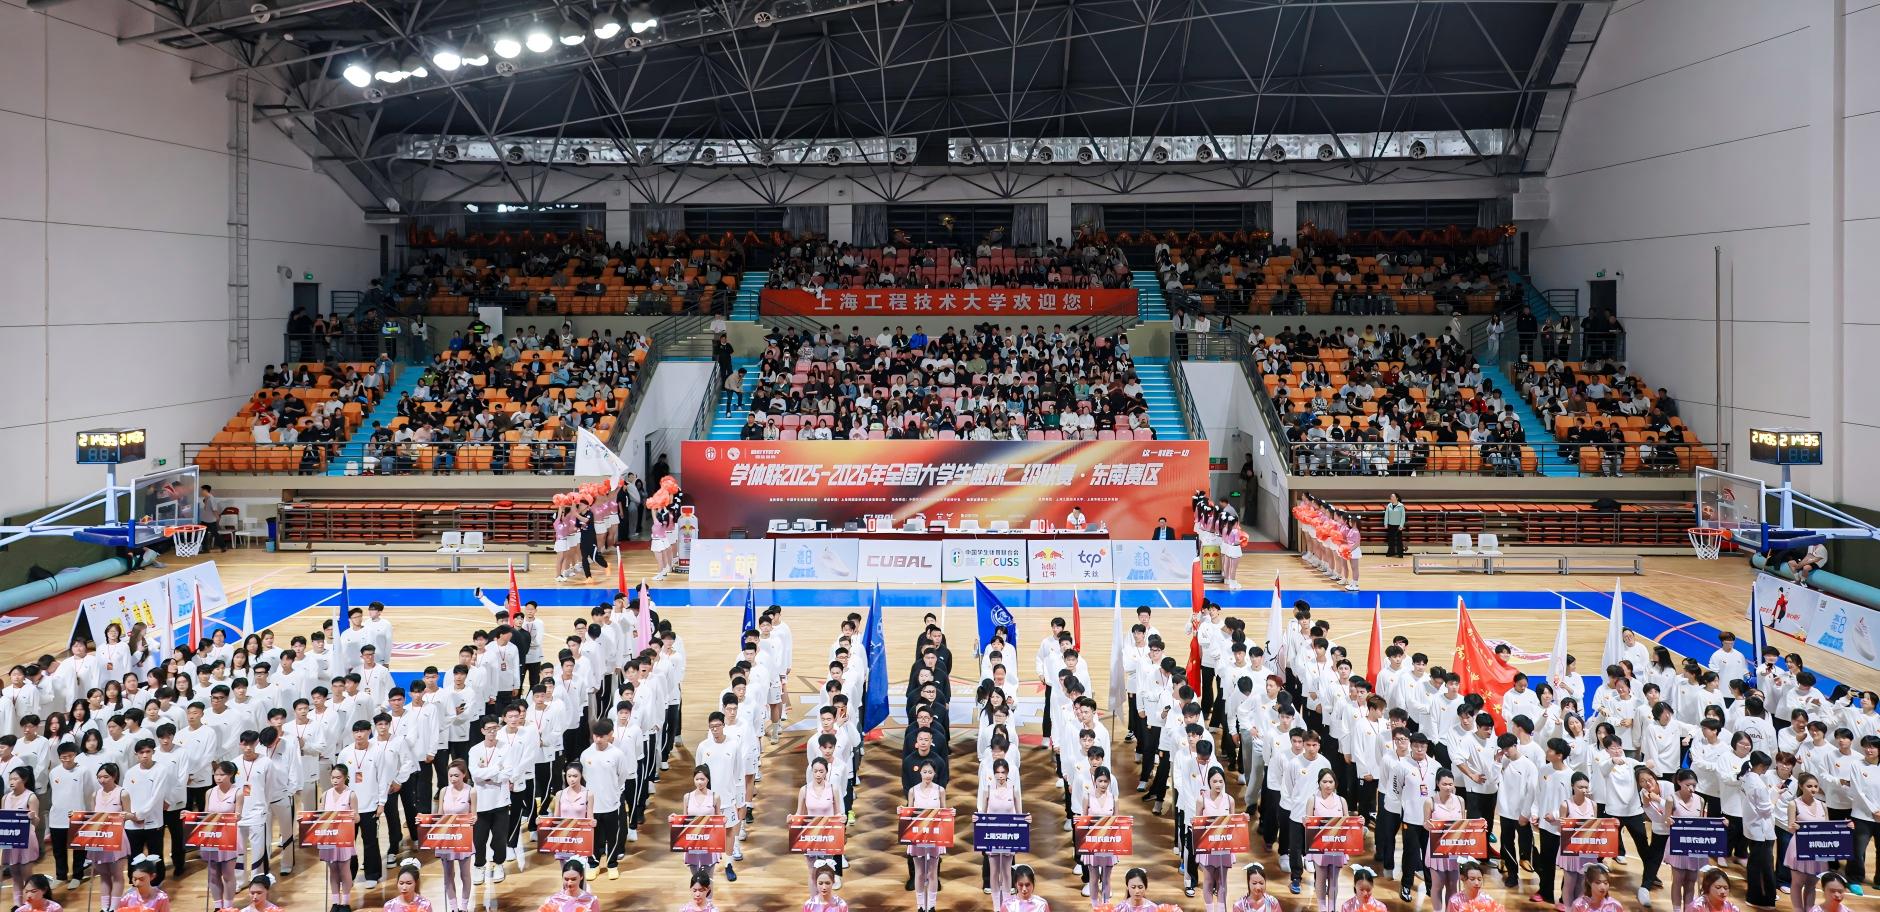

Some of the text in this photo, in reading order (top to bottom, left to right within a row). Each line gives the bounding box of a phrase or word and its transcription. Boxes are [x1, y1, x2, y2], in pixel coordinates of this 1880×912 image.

[867, 555, 932, 567] CUBAL
[979, 557, 1020, 567] FOCUSS
[1078, 550, 1102, 569] tcp
